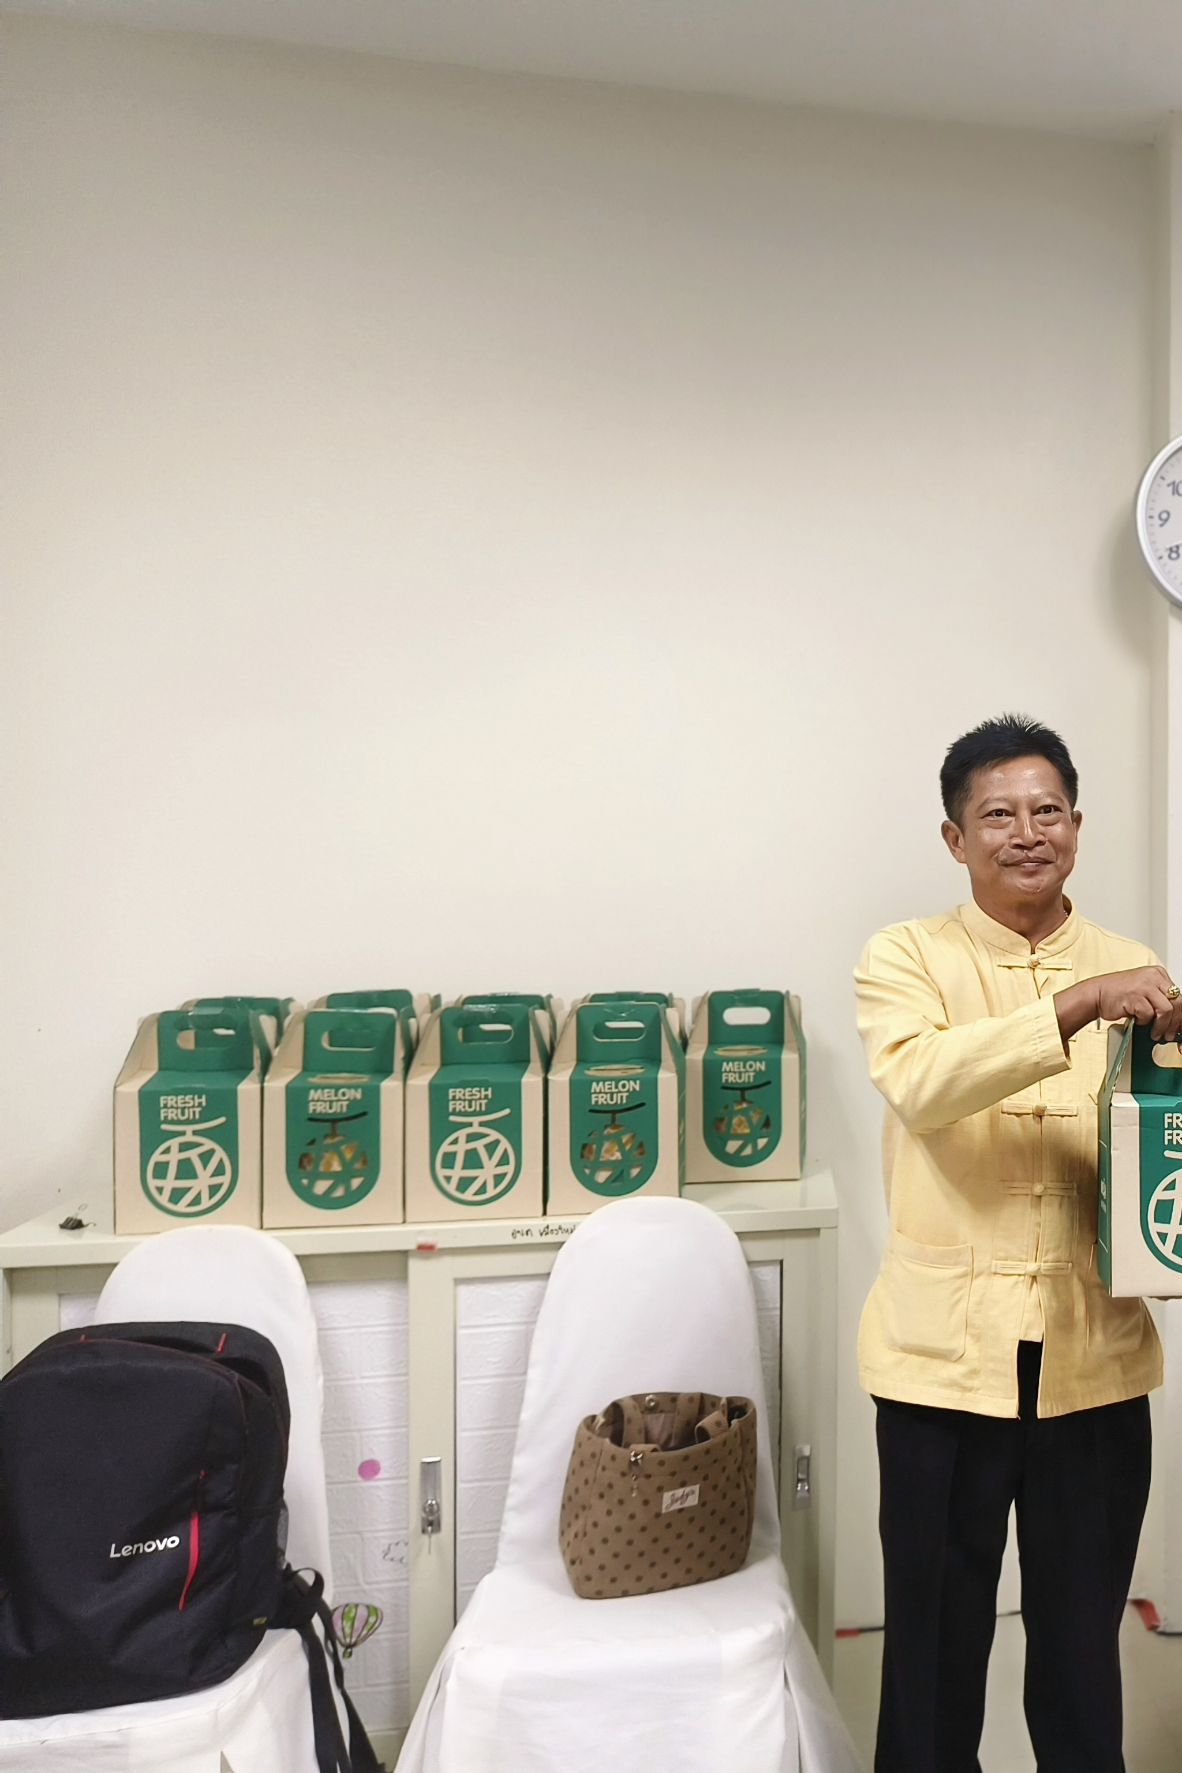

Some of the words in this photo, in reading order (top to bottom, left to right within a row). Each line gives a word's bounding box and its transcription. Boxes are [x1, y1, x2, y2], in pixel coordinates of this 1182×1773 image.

[1158, 510, 1171, 528] 9
[1167, 545, 1181, 561] 8
[721, 1060, 766, 1072] MELON
[721, 1072, 756, 1083] FRUIT
[590, 1080, 640, 1093] MELON
[308, 1088, 362, 1101] MELON
[448, 1087, 492, 1100] FRESH
[591, 1093, 629, 1105] FRUIT
[159, 1094, 207, 1107] FRESH
[448, 1100, 488, 1113] FRUIT
[159, 1107, 203, 1121] FRUIT
[308, 1101, 350, 1114] FRUIT
[109, 1535, 180, 1558] Lenovo
